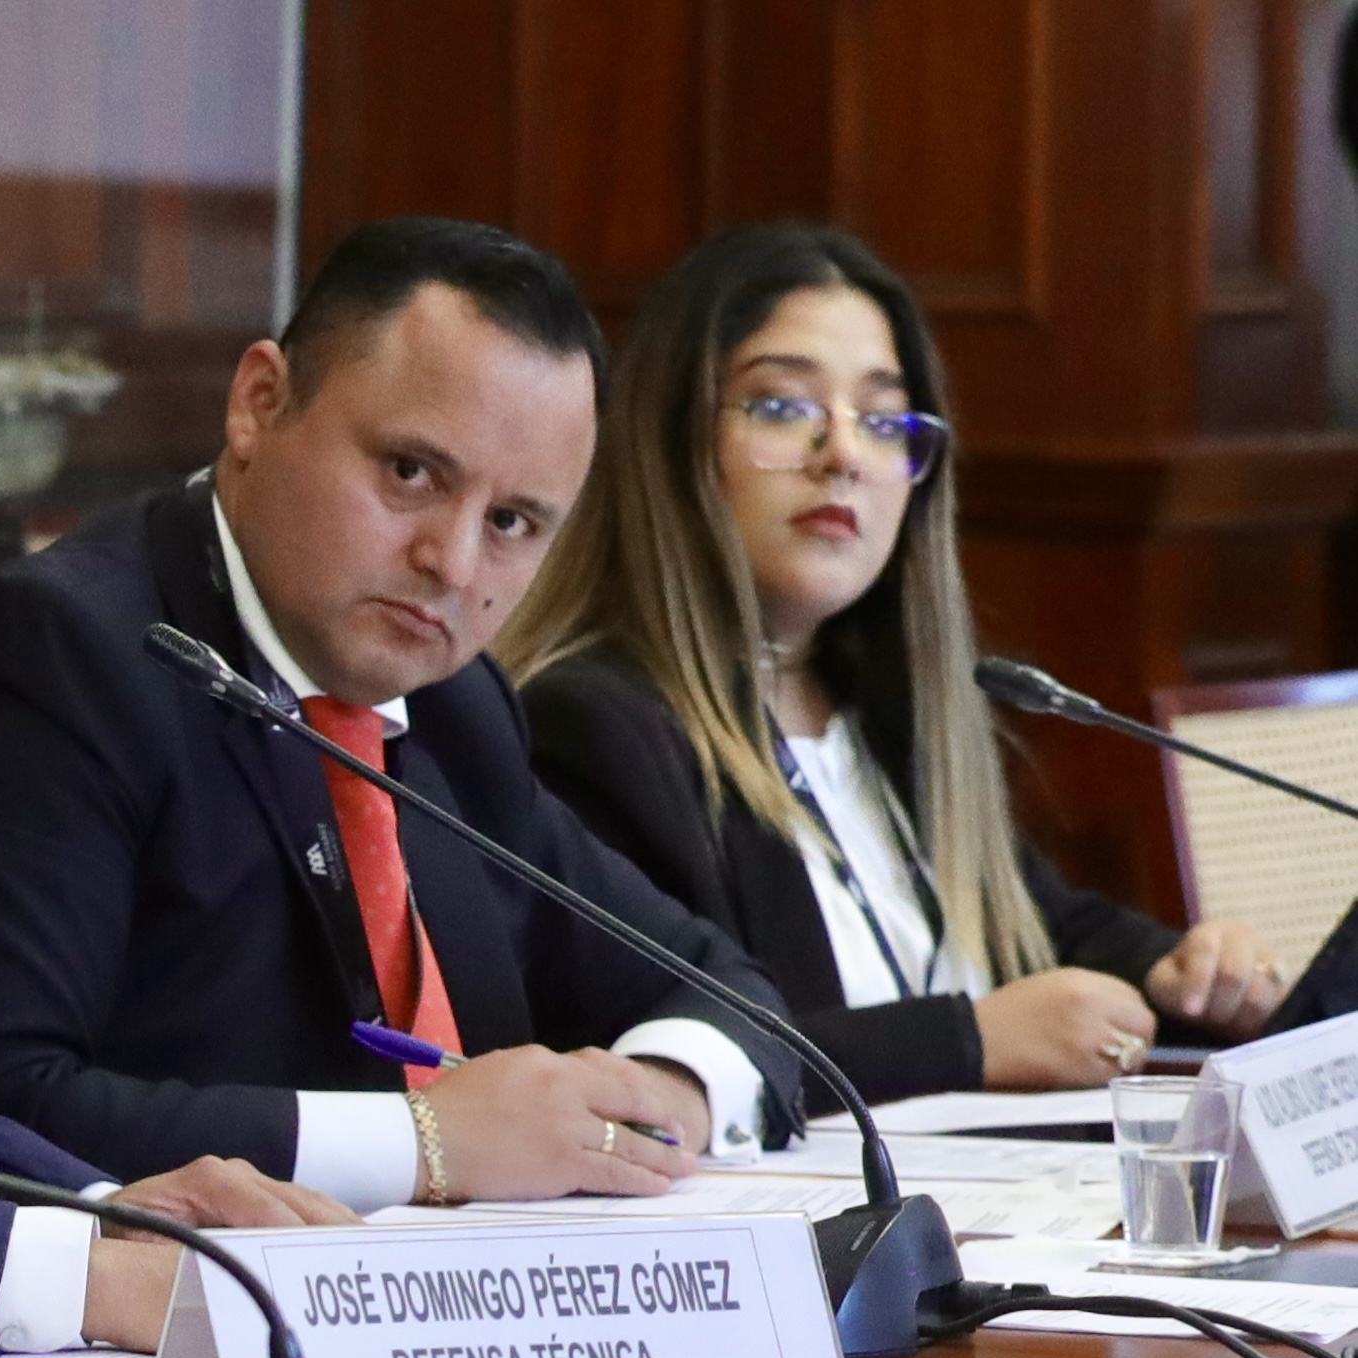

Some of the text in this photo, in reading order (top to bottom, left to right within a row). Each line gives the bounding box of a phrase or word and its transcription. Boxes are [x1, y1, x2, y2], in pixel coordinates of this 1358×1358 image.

[303, 1250, 740, 1326] JOSÉ DOMINGO PÉREZ GÓMEZ
